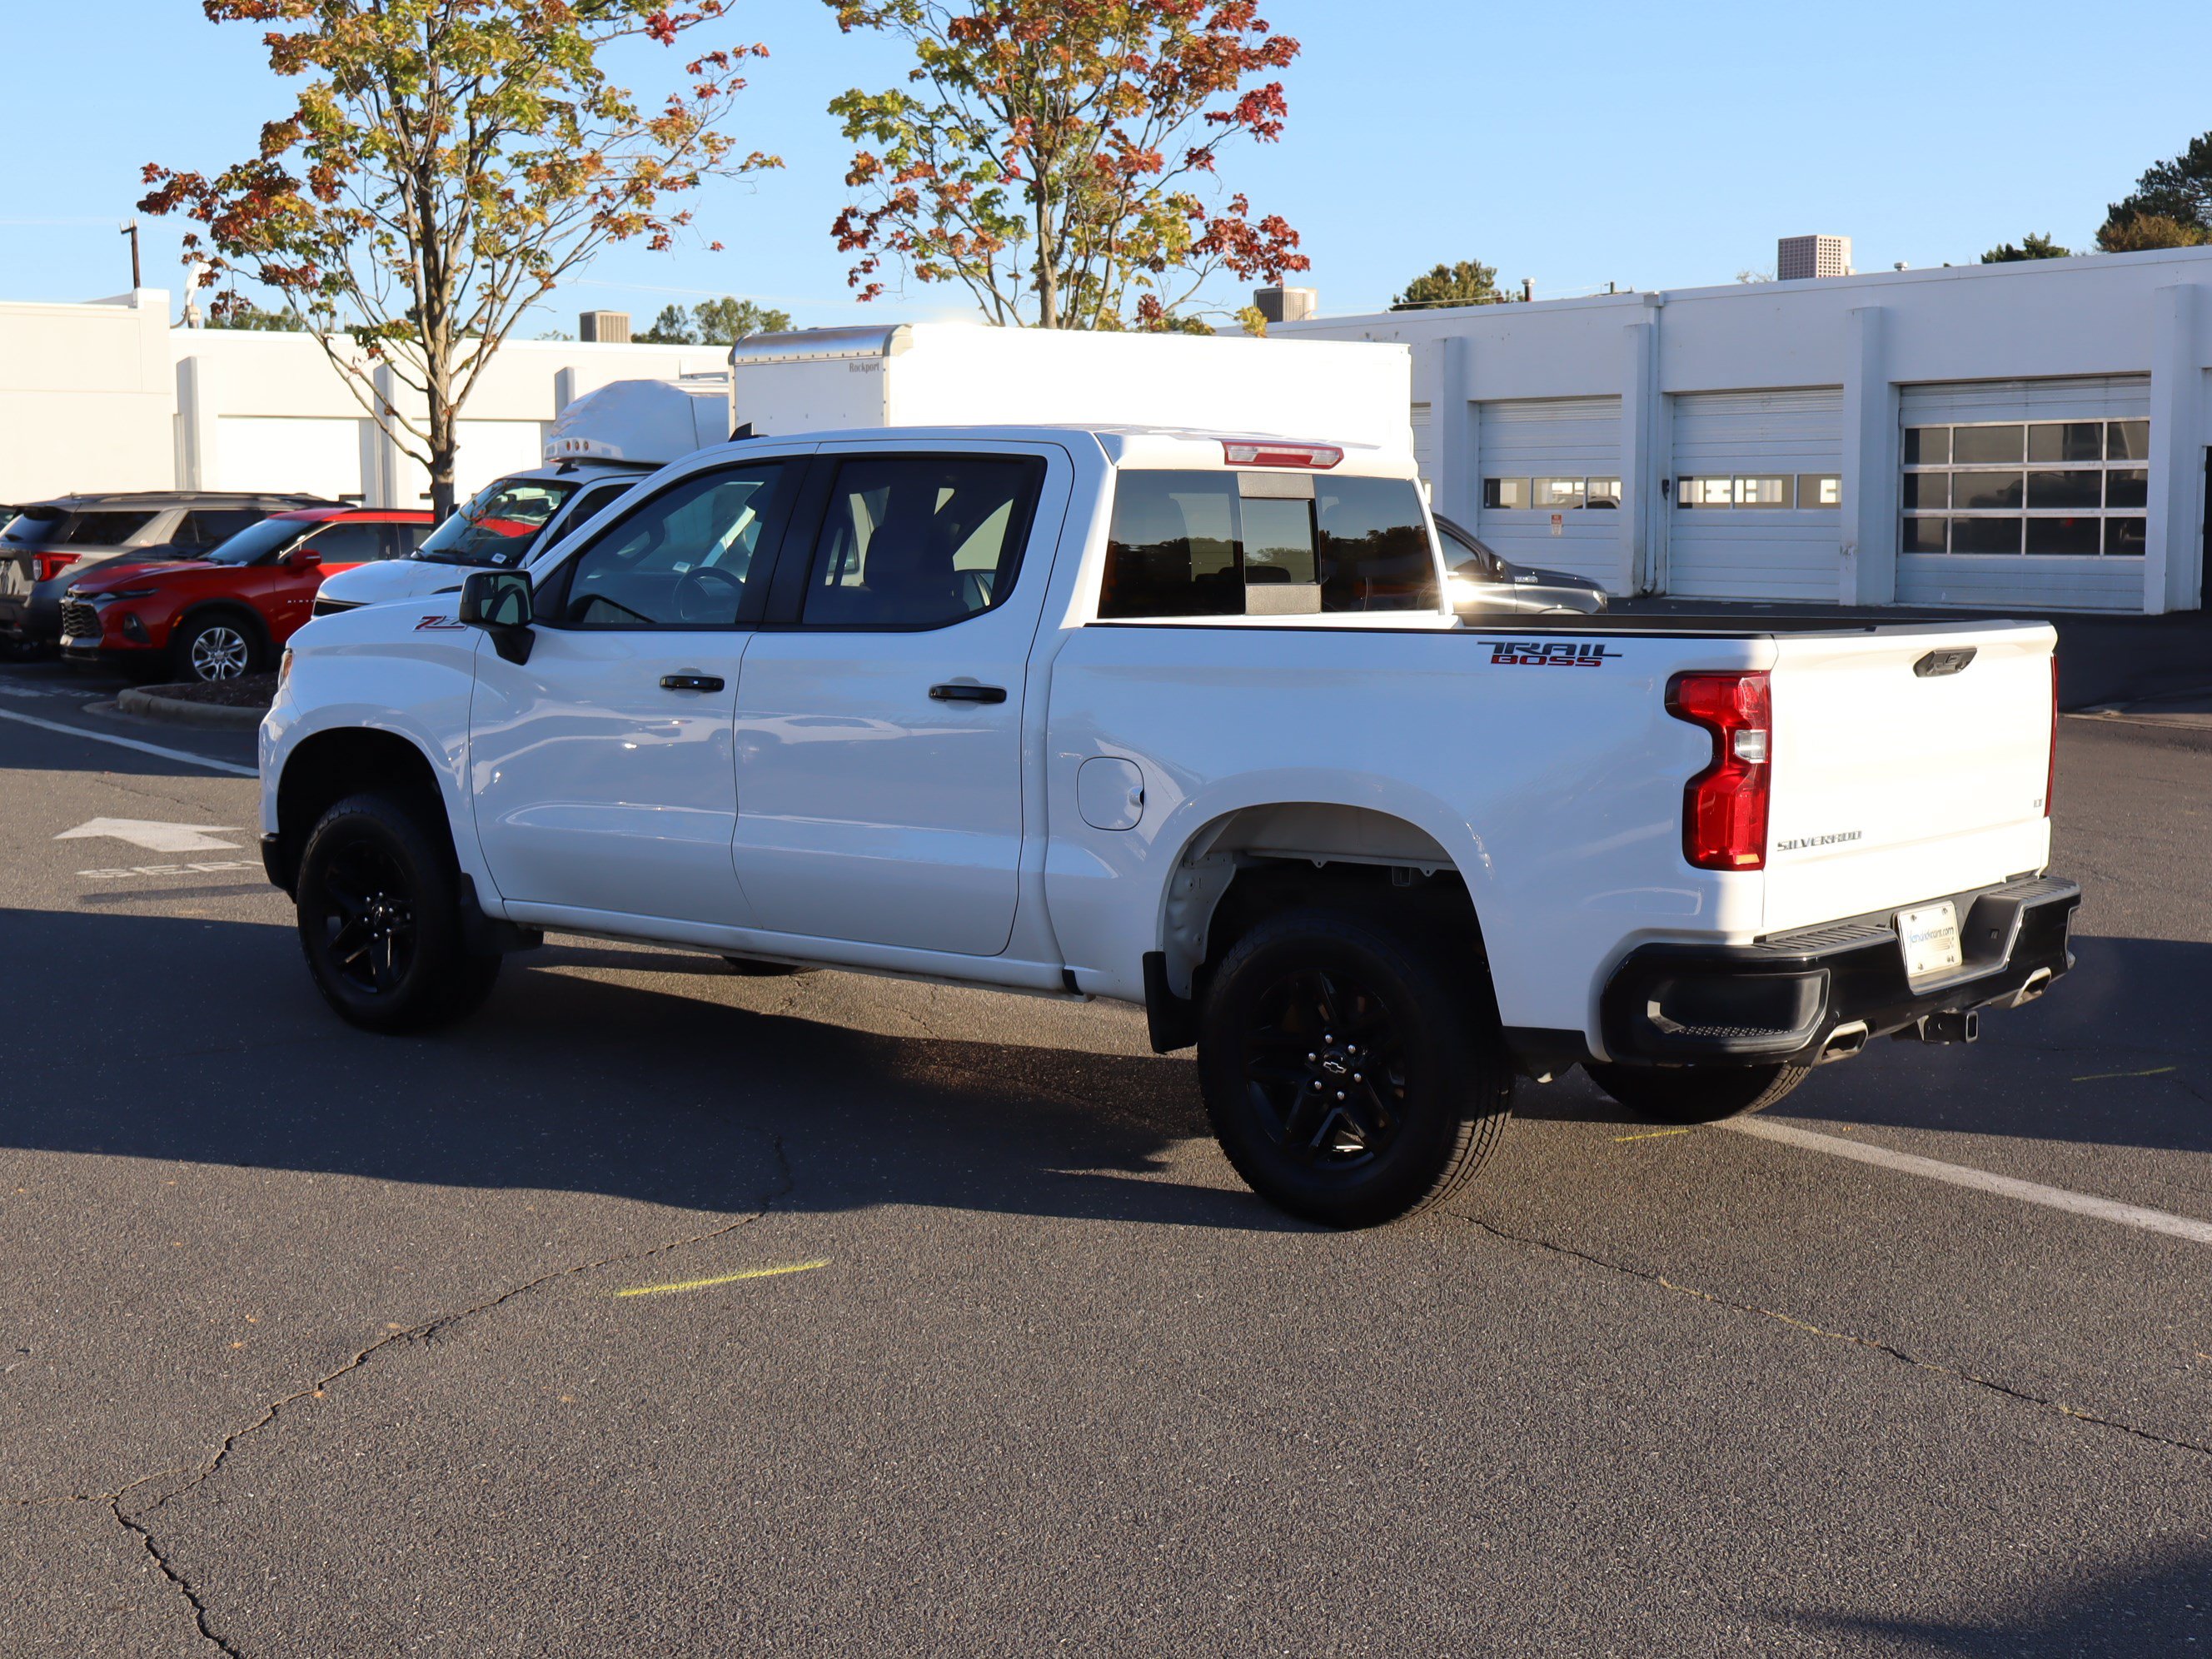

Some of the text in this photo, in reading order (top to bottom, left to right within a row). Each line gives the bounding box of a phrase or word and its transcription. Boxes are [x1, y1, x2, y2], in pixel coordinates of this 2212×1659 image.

[849, 361, 880, 375] Rockport
[1477, 640, 1623, 658] TRAIL
[1490, 654, 1603, 667] BOSS
[1776, 830, 1863, 852] SILVERADO
